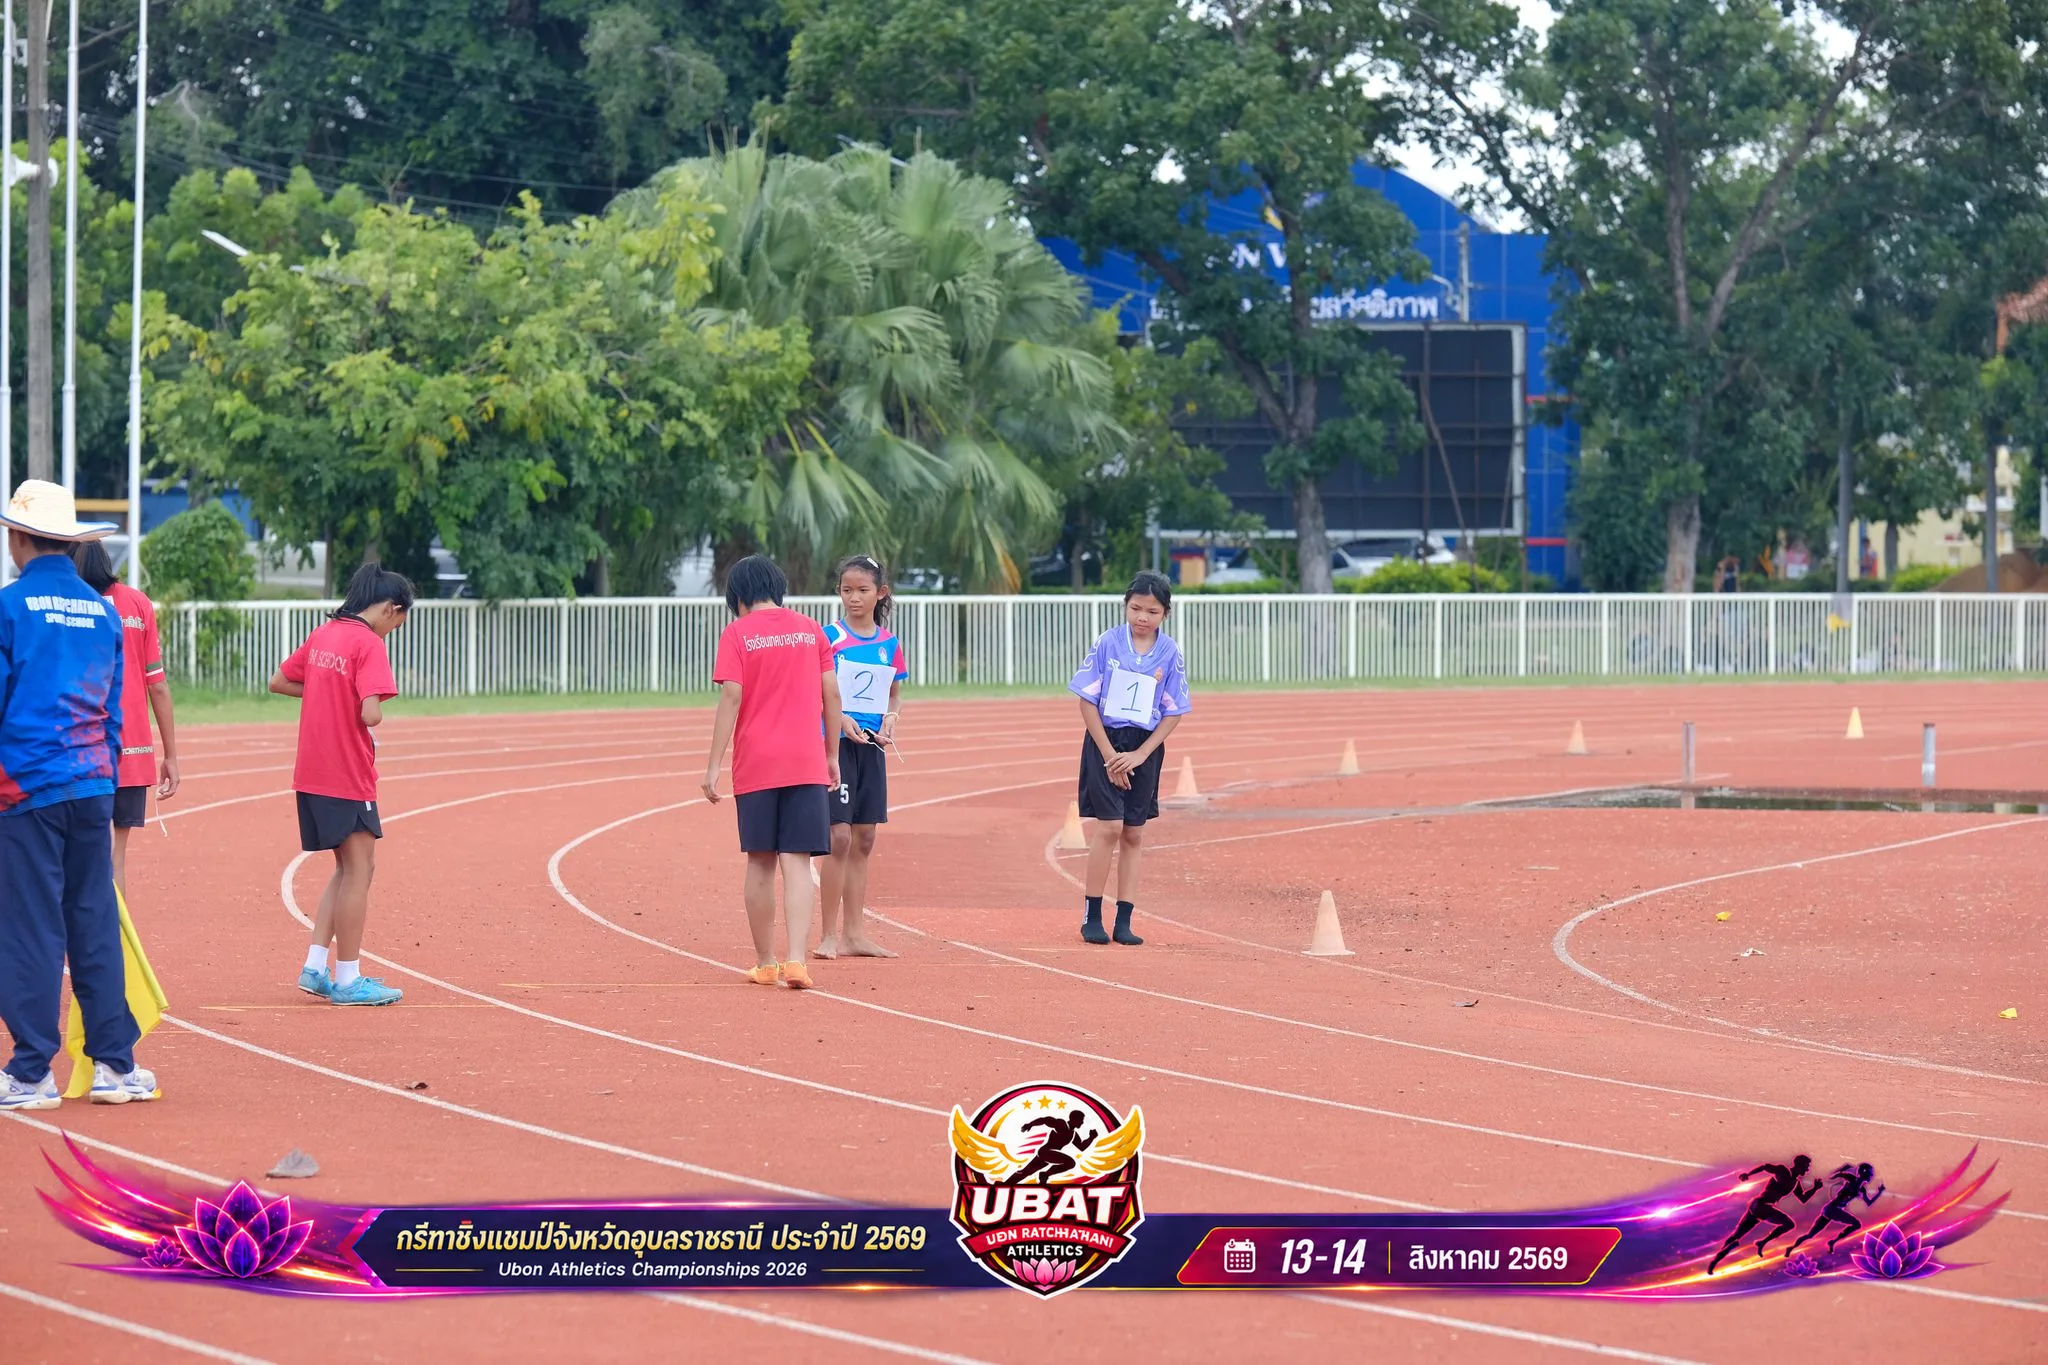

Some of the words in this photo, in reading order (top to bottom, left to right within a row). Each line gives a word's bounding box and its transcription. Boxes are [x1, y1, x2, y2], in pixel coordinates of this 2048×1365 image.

[45, 612, 66, 625] SPOR
[66, 616, 95, 629] SCHOOL
[852, 670, 875, 701] 2
[1121, 681, 1142, 713] 1
[839, 784, 850, 804] 5
